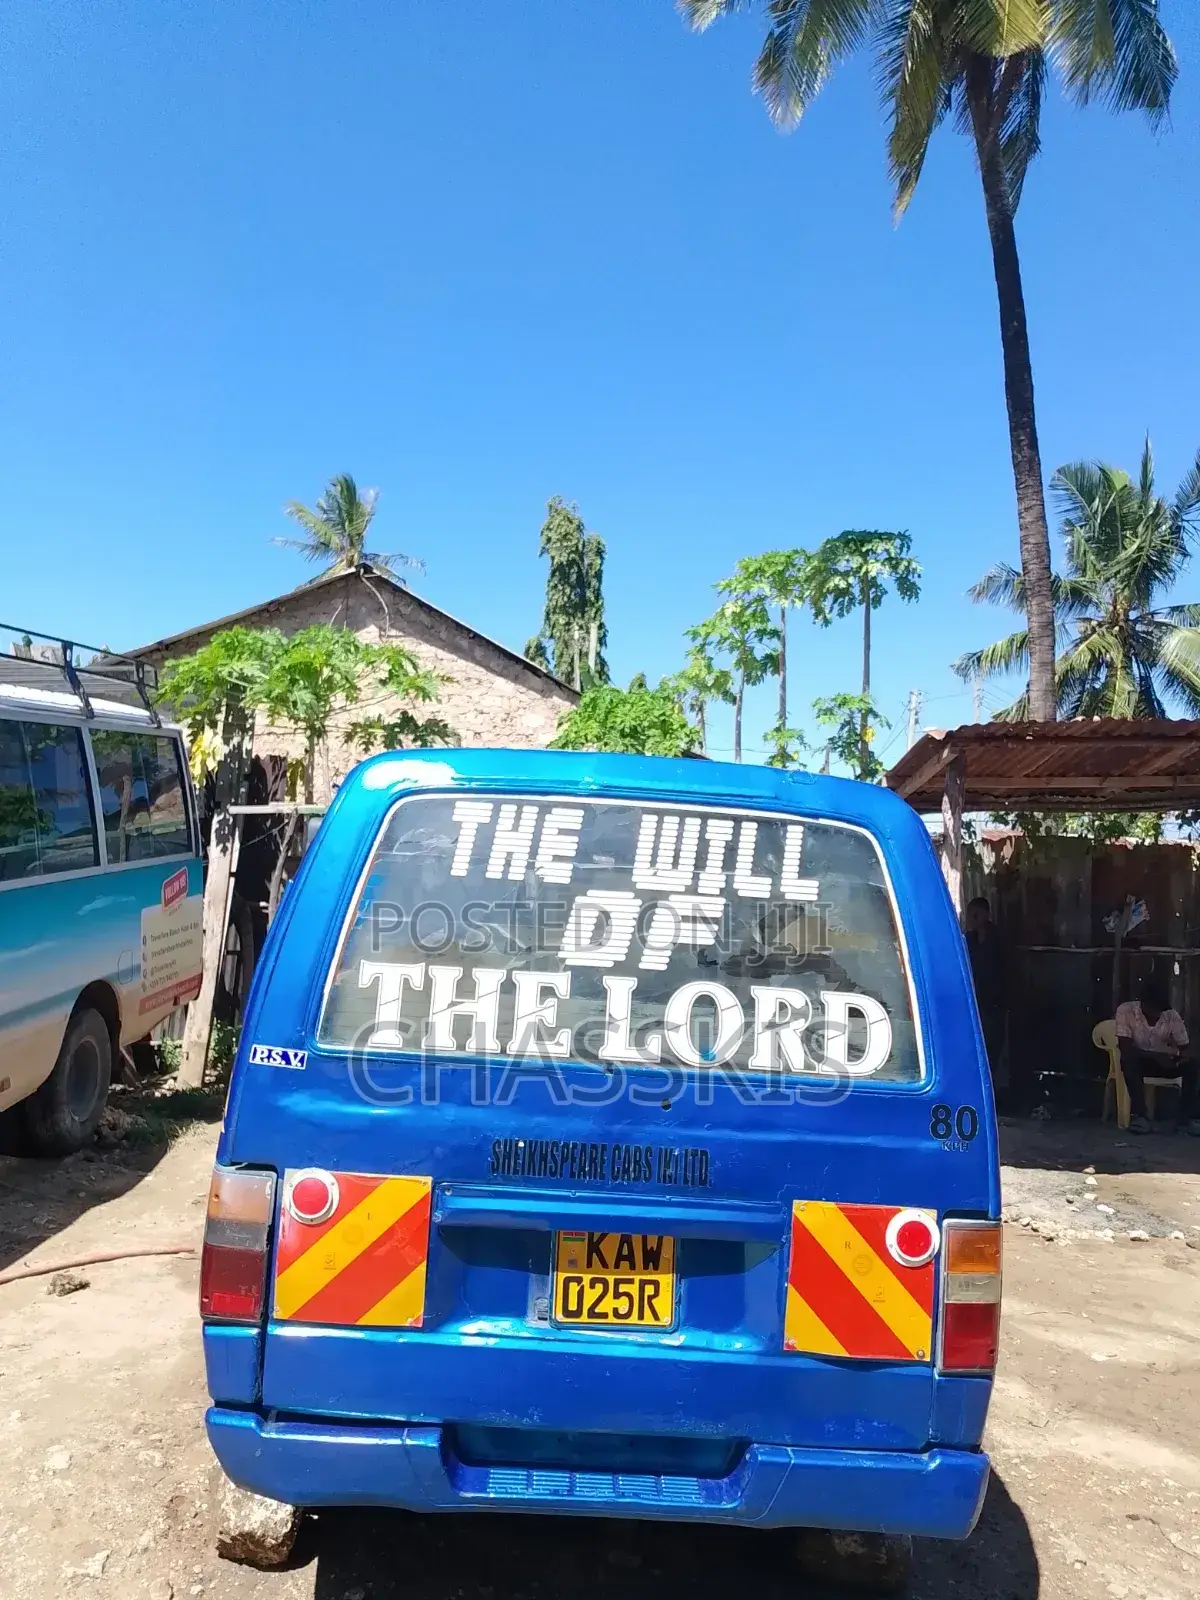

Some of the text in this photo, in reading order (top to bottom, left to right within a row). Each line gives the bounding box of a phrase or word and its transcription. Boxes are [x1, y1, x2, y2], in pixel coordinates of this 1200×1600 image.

[450, 800, 820, 901] THE WILL
[557, 889, 726, 971] OF
[357, 960, 893, 1077] THE LORD
[929, 1104, 979, 1142] 80
[491, 1138, 608, 1182] SHEIKHSPEARE
[611, 1143, 653, 1184] CABS
[586, 1231, 663, 1272] KAW
[562, 1275, 661, 1322] 025R
